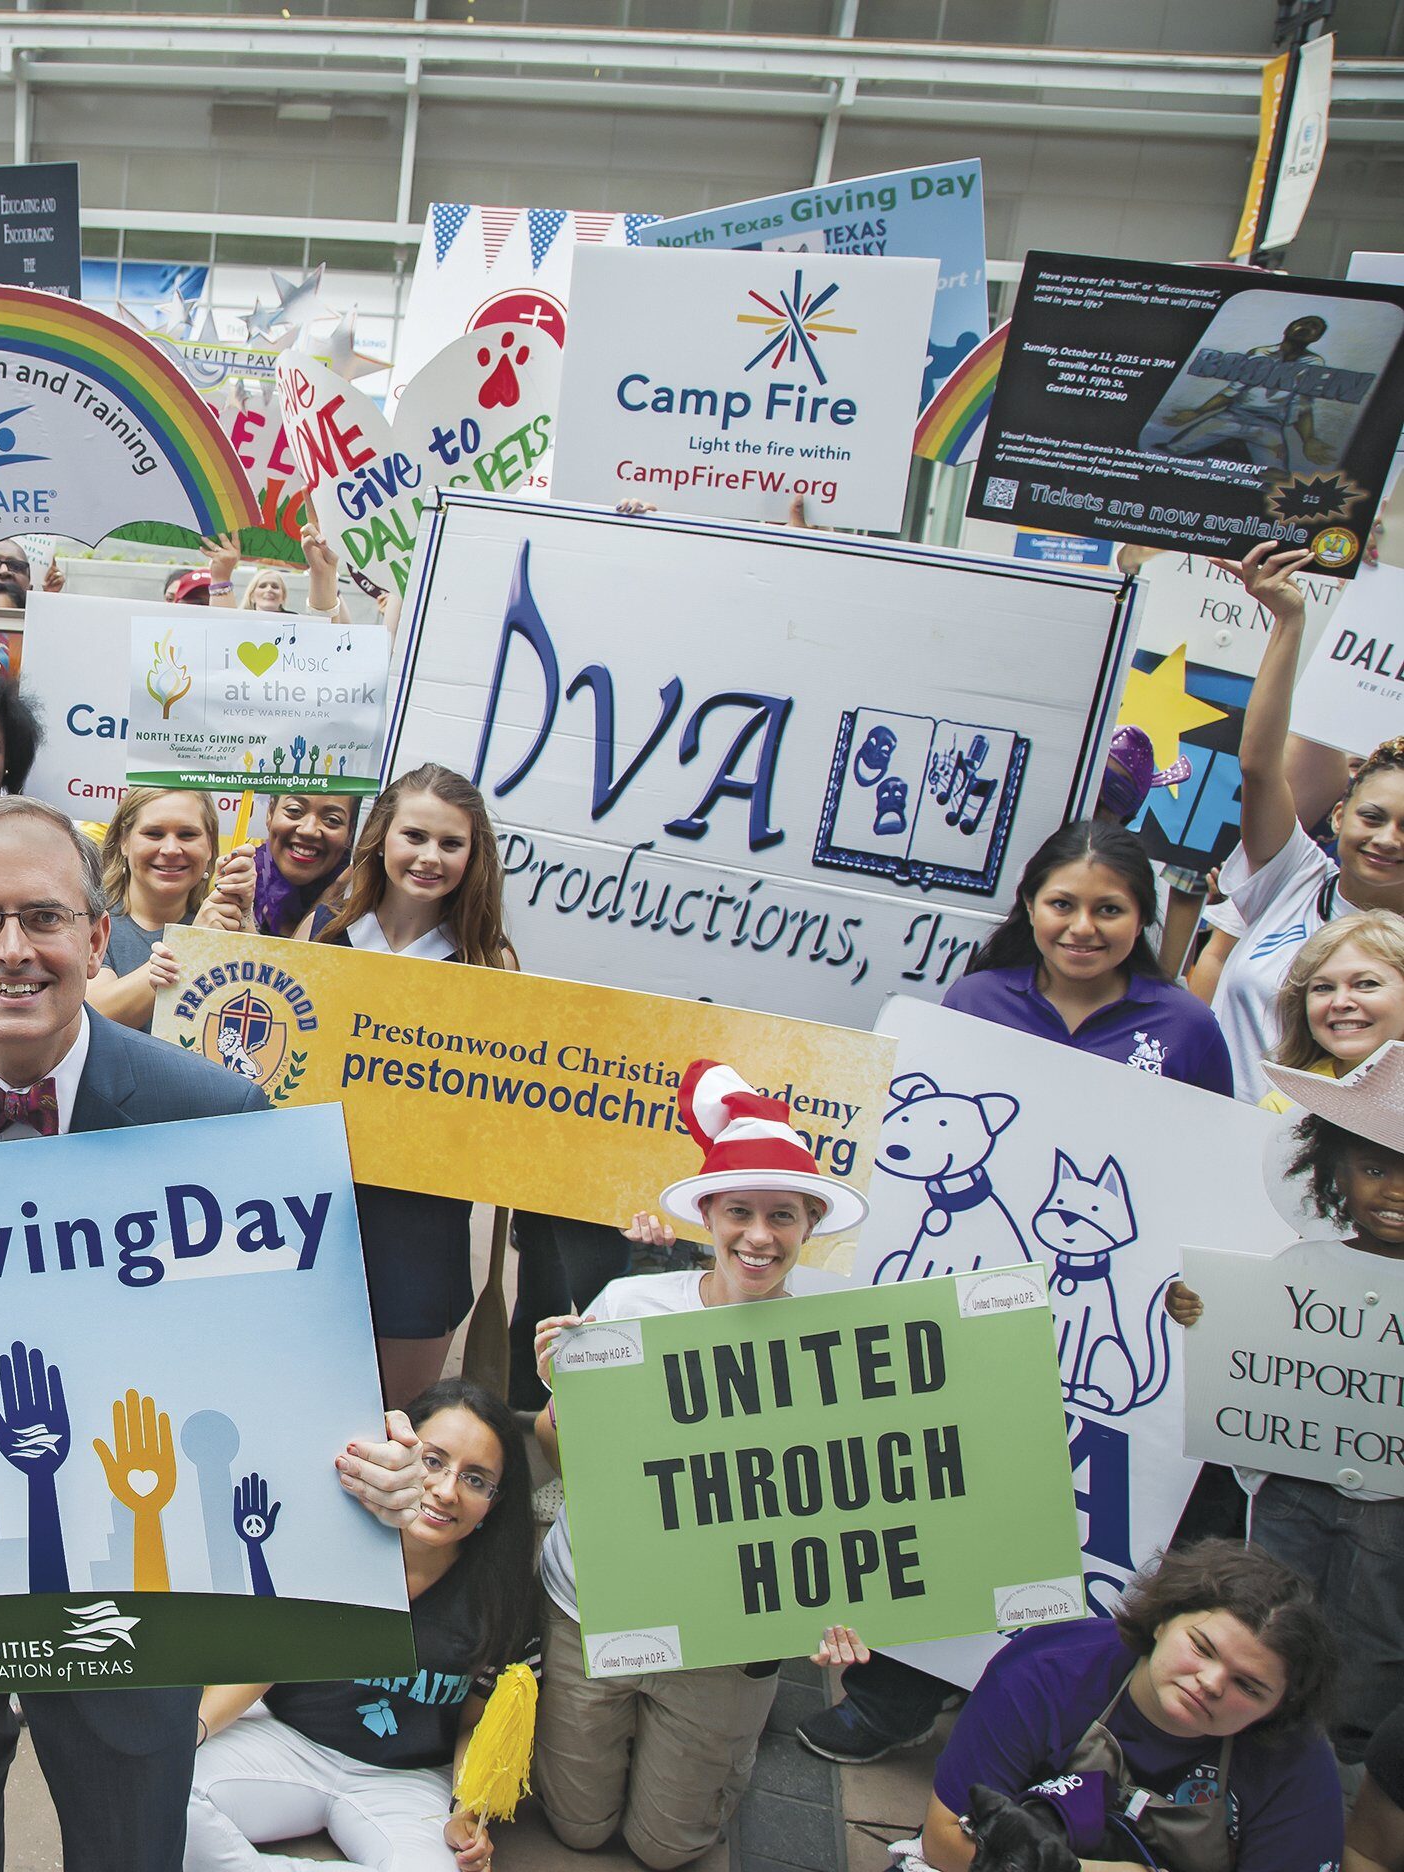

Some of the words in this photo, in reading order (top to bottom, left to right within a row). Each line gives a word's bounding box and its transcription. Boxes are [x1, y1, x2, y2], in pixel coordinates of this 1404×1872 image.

[657, 227, 715, 248] North
[721, 213, 784, 238] Texas
[790, 186, 897, 222] Giving
[910, 173, 976, 201] Day
[824, 219, 887, 246] TEXAS
[1039, 272, 1060, 281] Have
[1104, 290, 1149, 304] something
[1150, 295, 1169, 304] that
[184, 346, 238, 364] LEVITT
[1022, 342, 1059, 356] Sunday,
[1060, 347, 1098, 359] October
[1115, 353, 1139, 365] 2015
[1140, 356, 1152, 366] at
[1152, 357, 1176, 369] 3PM
[1047, 358, 1089, 372] Granville
[1089, 363, 1110, 374] Arts
[1111, 366, 1144, 378] Center
[1046, 383, 1084, 396] Garland
[1085, 388, 1097, 398] TX
[1098, 389, 1128, 402] 75040
[1058, 372, 1076, 382] 300
[1089, 376, 1111, 388] Fifth
[1112, 378, 1125, 389] St.
[617, 374, 752, 430] Camp
[765, 383, 858, 426] Fire
[15, 361, 65, 395] and
[74, 379, 158, 476] Training
[473, 414, 552, 492] PETS
[689, 436, 730, 454] Light
[735, 439, 762, 456] the
[767, 441, 795, 457] fire
[799, 445, 851, 462] within
[1001, 431, 1026, 442] Visual
[1025, 434, 1060, 448] Teaching
[1061, 439, 1082, 450] From
[1082, 443, 1114, 455] Genesis
[1207, 458, 1268, 476] "BROKEN"
[1005, 455, 1059, 469] unconditional
[337, 452, 422, 521] Give
[428, 417, 481, 466] to
[616, 460, 838, 504] CampFireFW.org
[13, 516, 50, 524] care
[1031, 483, 1105, 512] Tickets
[1108, 500, 1145, 518] are
[1148, 504, 1200, 526] now
[1203, 515, 1309, 543] available
[1177, 553, 1193, 575] A
[1199, 599, 1242, 628] FOR
[224, 683, 251, 703] at
[263, 681, 307, 704] the
[316, 683, 378, 708] park
[472, 536, 796, 853] DVA
[1357, 680, 1378, 693] NEW
[1380, 687, 1403, 701] LIFE
[223, 708, 255, 717] KLYDE
[258, 709, 302, 718] WARREN
[304, 710, 331, 719] PARK
[135, 731, 171, 742] NORTH
[174, 733, 205, 743] TEXAS
[209, 735, 245, 745] GIVING
[248, 736, 268, 745] DAY
[169, 743, 202, 754] September
[217, 745, 237, 753] 2015
[179, 773, 329, 788] www.NorthTexasGivingDay.org
[496, 831, 871, 986] Productions,
[173, 960, 319, 1033] PRESTONWOOD
[351, 1012, 548, 1067] Prestonwood
[556, 1046, 682, 1089] Christia
[1284, 1284, 1365, 1339] YOU
[585, 1350, 609, 1363] Through
[663, 1319, 947, 1424] UNITED
[1216, 1406, 1321, 1452] CURE
[1334, 1425, 1404, 1466] FOR
[643, 1424, 967, 1531] THROUGH
[737, 1524, 926, 1616] HOPE
[1006, 1608, 1024, 1621] United
[1024, 1606, 1048, 1620] Through
[57, 1662, 72, 1682] of
[77, 1659, 134, 1676] TEXAS
[601, 1656, 621, 1668] United
[620, 1654, 644, 1667] Through
